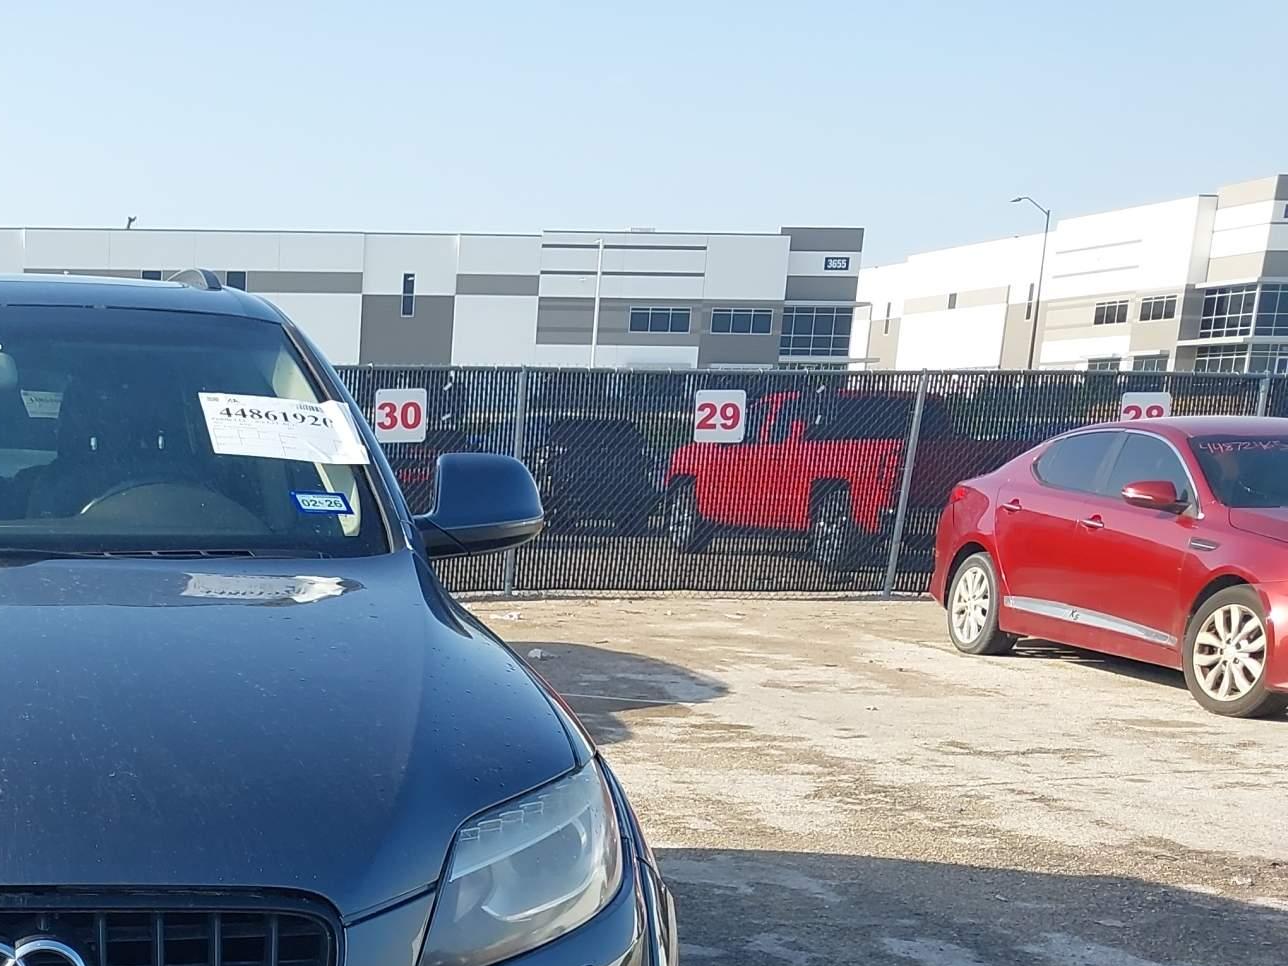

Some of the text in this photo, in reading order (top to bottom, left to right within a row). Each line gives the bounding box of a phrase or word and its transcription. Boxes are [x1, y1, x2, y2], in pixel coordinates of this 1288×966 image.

[826, 258, 847, 269] 3655
[376, 401, 422, 430] 30
[695, 402, 741, 430] 29
